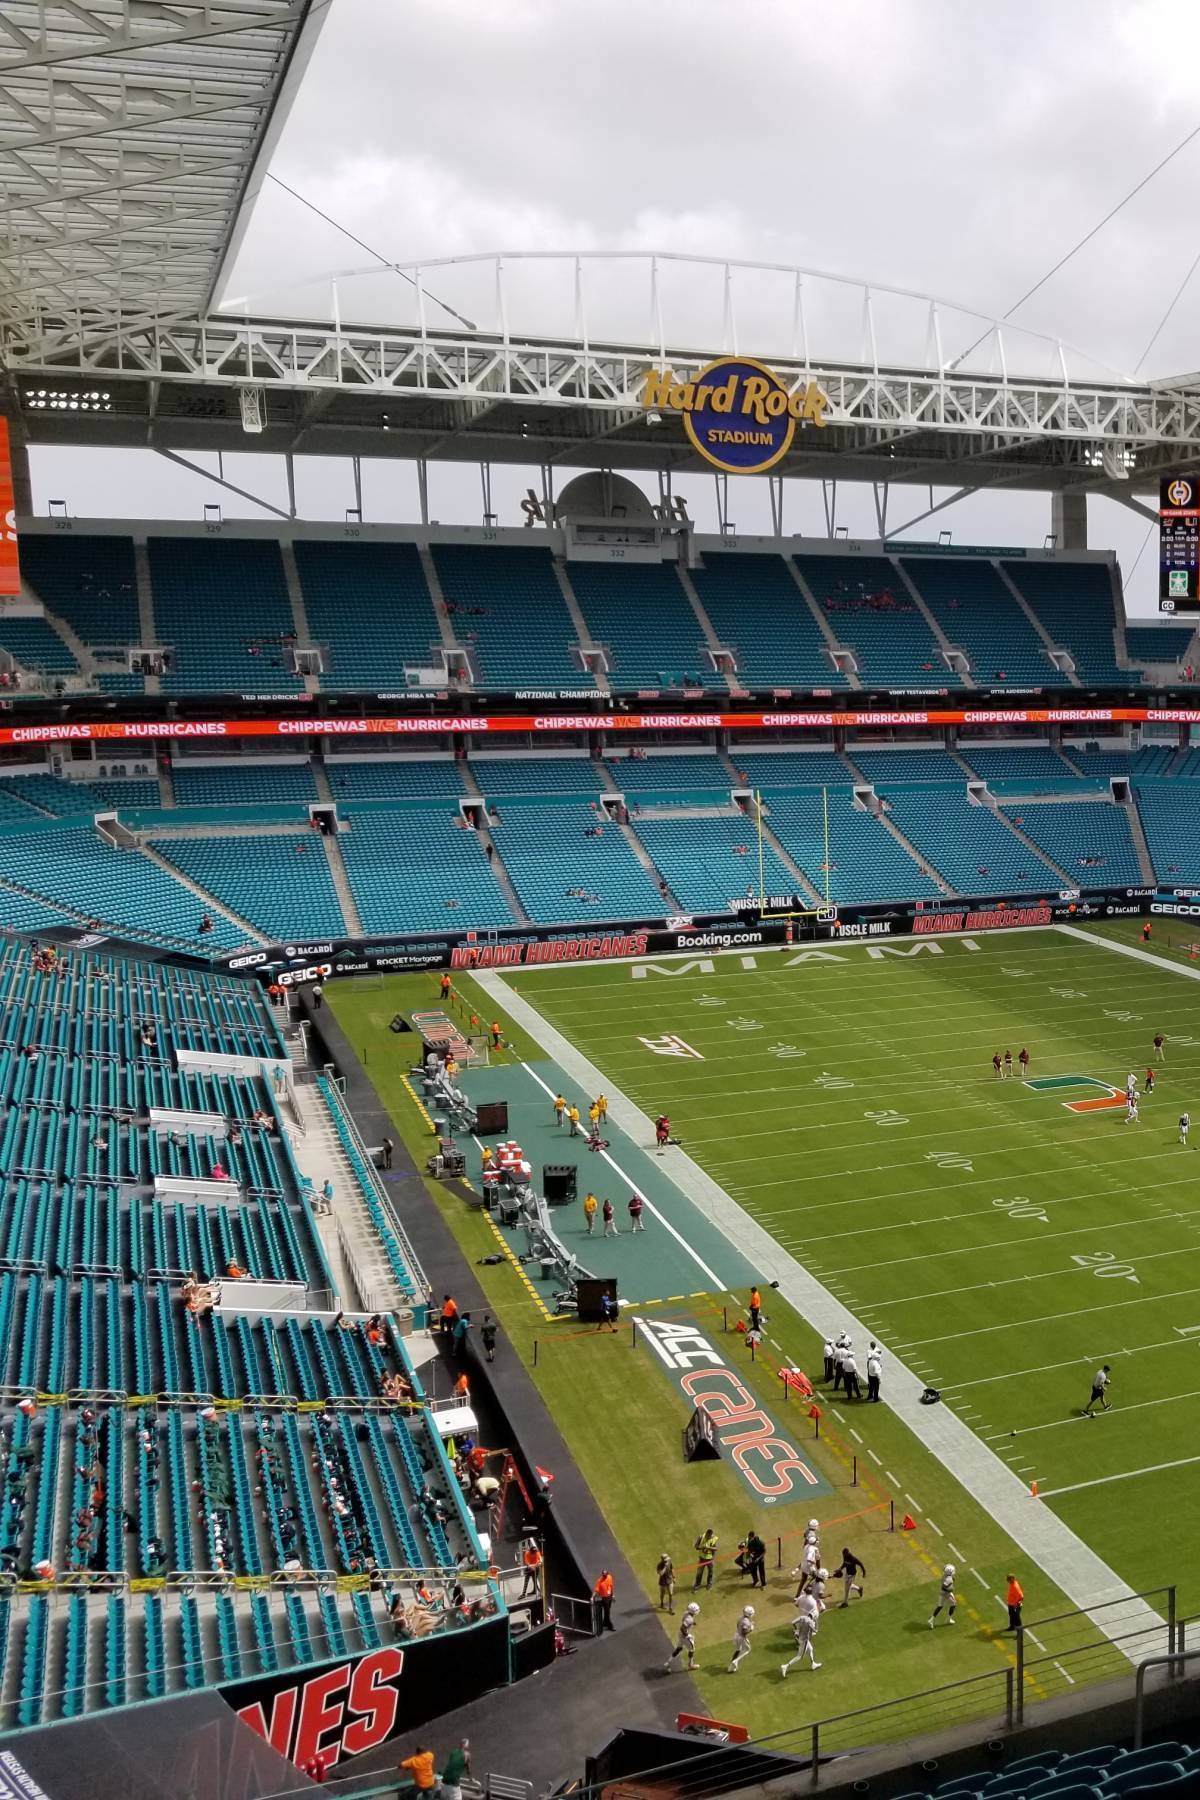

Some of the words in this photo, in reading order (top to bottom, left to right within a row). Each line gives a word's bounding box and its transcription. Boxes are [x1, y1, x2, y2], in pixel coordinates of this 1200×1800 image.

[641, 369, 739, 412] Hard
[742, 376, 827, 427] Rock
[707, 428, 773, 446] STADIUM
[515, 691, 557, 699] NATIONAL
[559, 690, 610, 699] CHAMPIONS
[534, 716, 613, 728] CHIPPEWAS
[640, 715, 721, 727] HURRICANES
[762, 714, 832, 725] CHIPPEWAS
[857, 713, 928, 724] HURRICANES
[964, 711, 1027, 722] CHIPPEWAS
[1048, 710, 1112, 720] HURRICANES
[12, 725, 91, 741] CHIPPEWAS
[125, 721, 226, 737] HURRICANES
[278, 721, 367, 733] CHIPPEWAS
[397, 718, 488, 732] HURRICANES
[731, 898, 769, 910] MUSCLE
[770, 896, 793, 908] MILK
[869, 921, 891, 935] MILK
[912, 912, 964, 934] MIAMI
[966, 907, 1052, 930] HURRICANES
[677, 931, 762, 948] Booking.com
[297, 943, 333, 954] BACARDÍ
[525, 934, 648, 963] HURRICANES
[229, 952, 267, 969] GEICO
[376, 956, 409, 965] ROCKET
[409, 955, 443, 963] Mortgage
[631, 939, 981, 978] MIAMI
[636, 1035, 706, 1060] ACC
[767, 1045, 807, 1058] 30
[864, 1109, 910, 1126] 50
[923, 1151, 973, 1169] 40
[992, 1196, 1047, 1219] 30
[1070, 1251, 1136, 1279] 20
[631, 1316, 725, 1369] ACC
